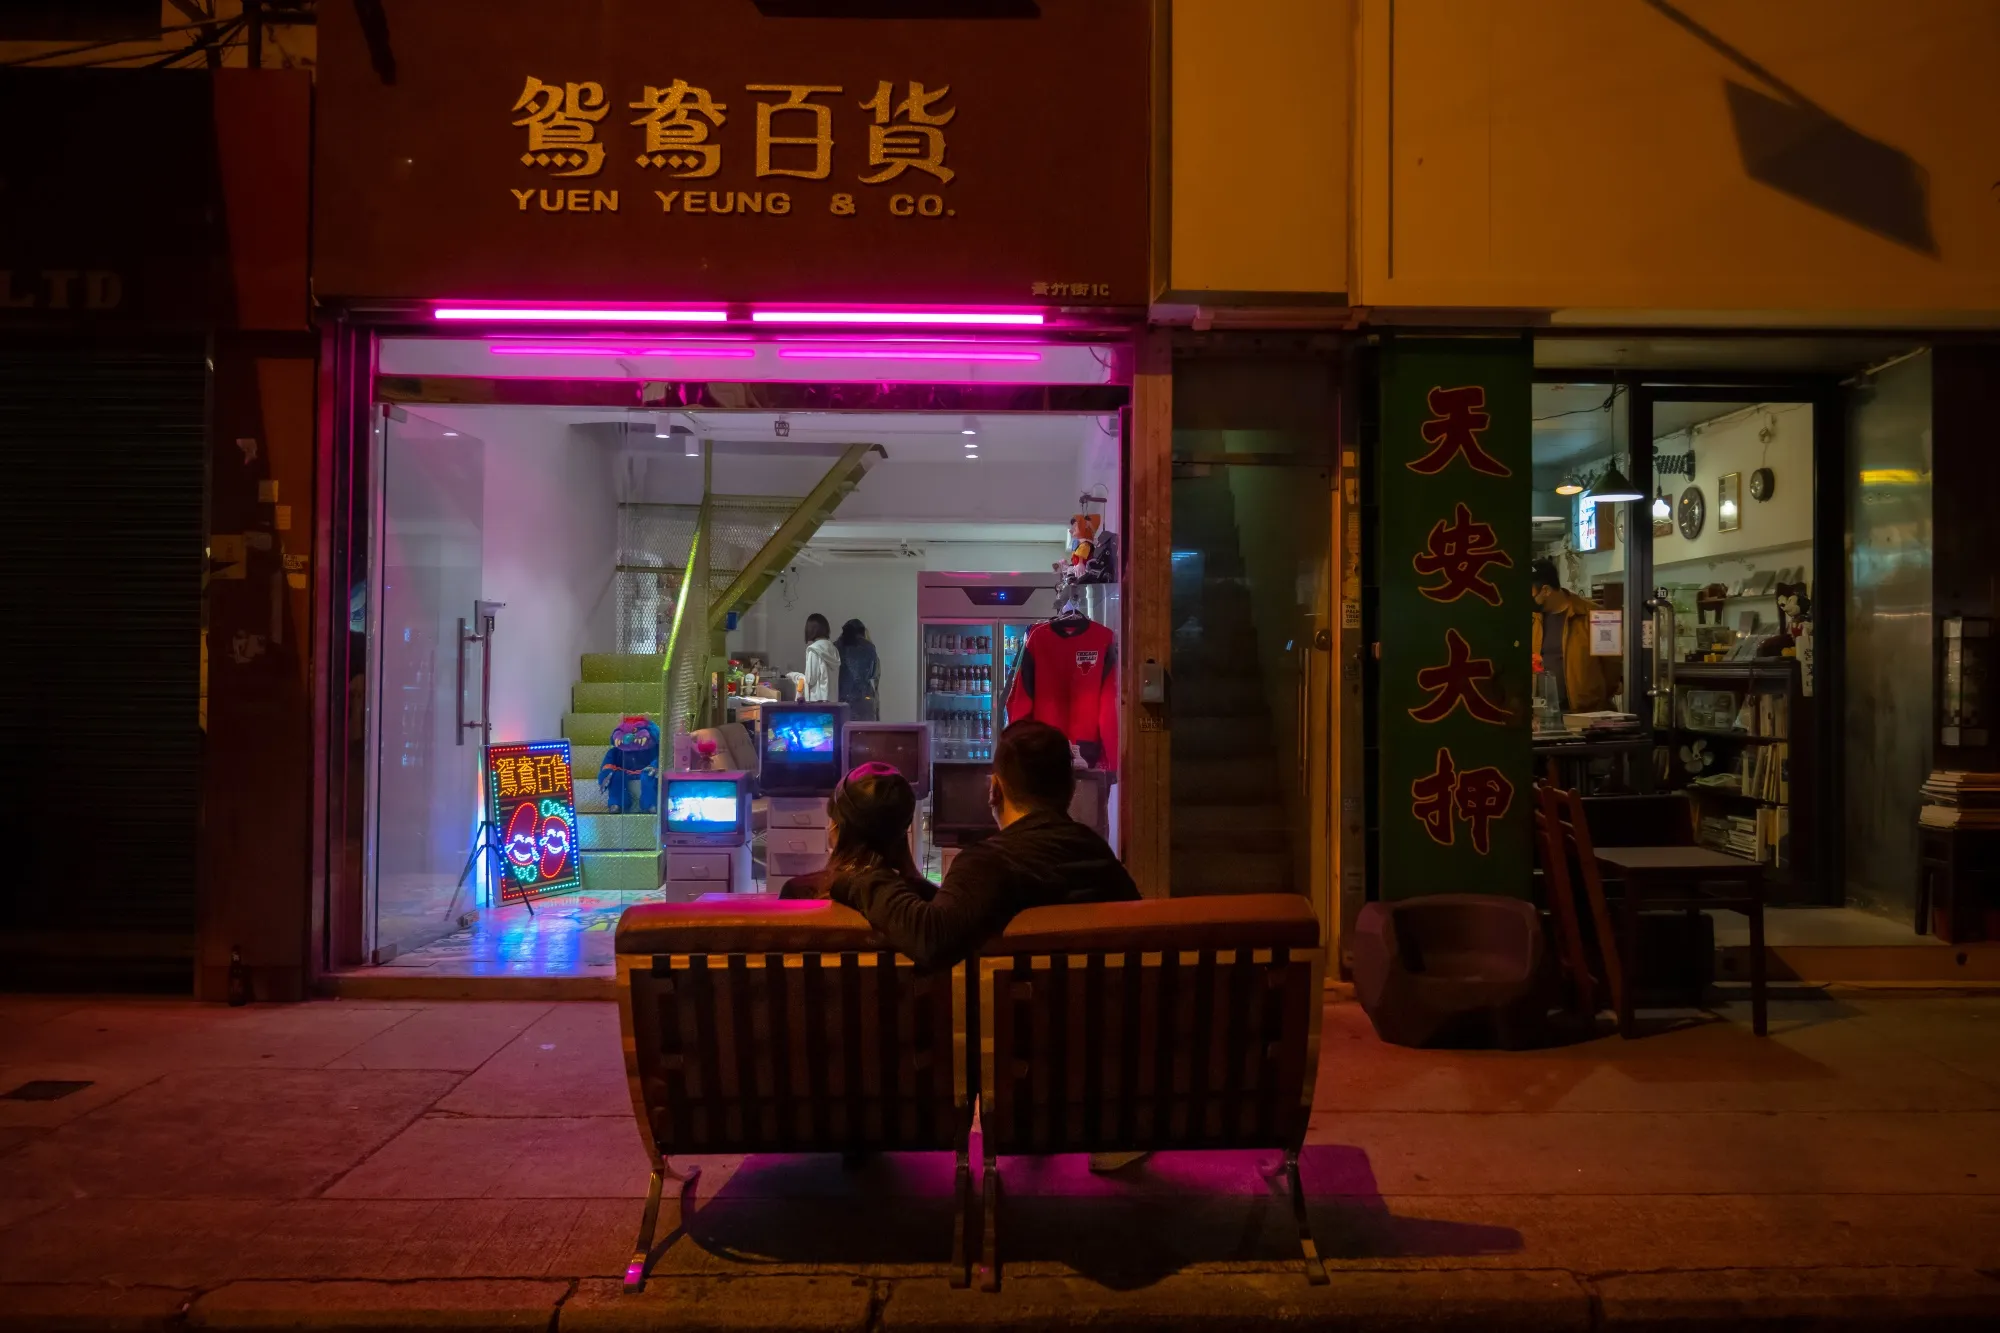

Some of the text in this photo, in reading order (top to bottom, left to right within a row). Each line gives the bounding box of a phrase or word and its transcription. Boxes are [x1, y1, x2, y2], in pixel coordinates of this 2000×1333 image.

[511, 75, 956, 185] 鴛鴦百貨
[510, 188, 956, 217] YUEN YEUNG & CO.
[0, 269, 123, 310] LTD
[1404, 384, 1515, 855] 天安大押
[496, 754, 568, 797] 鴛鴦百貨
